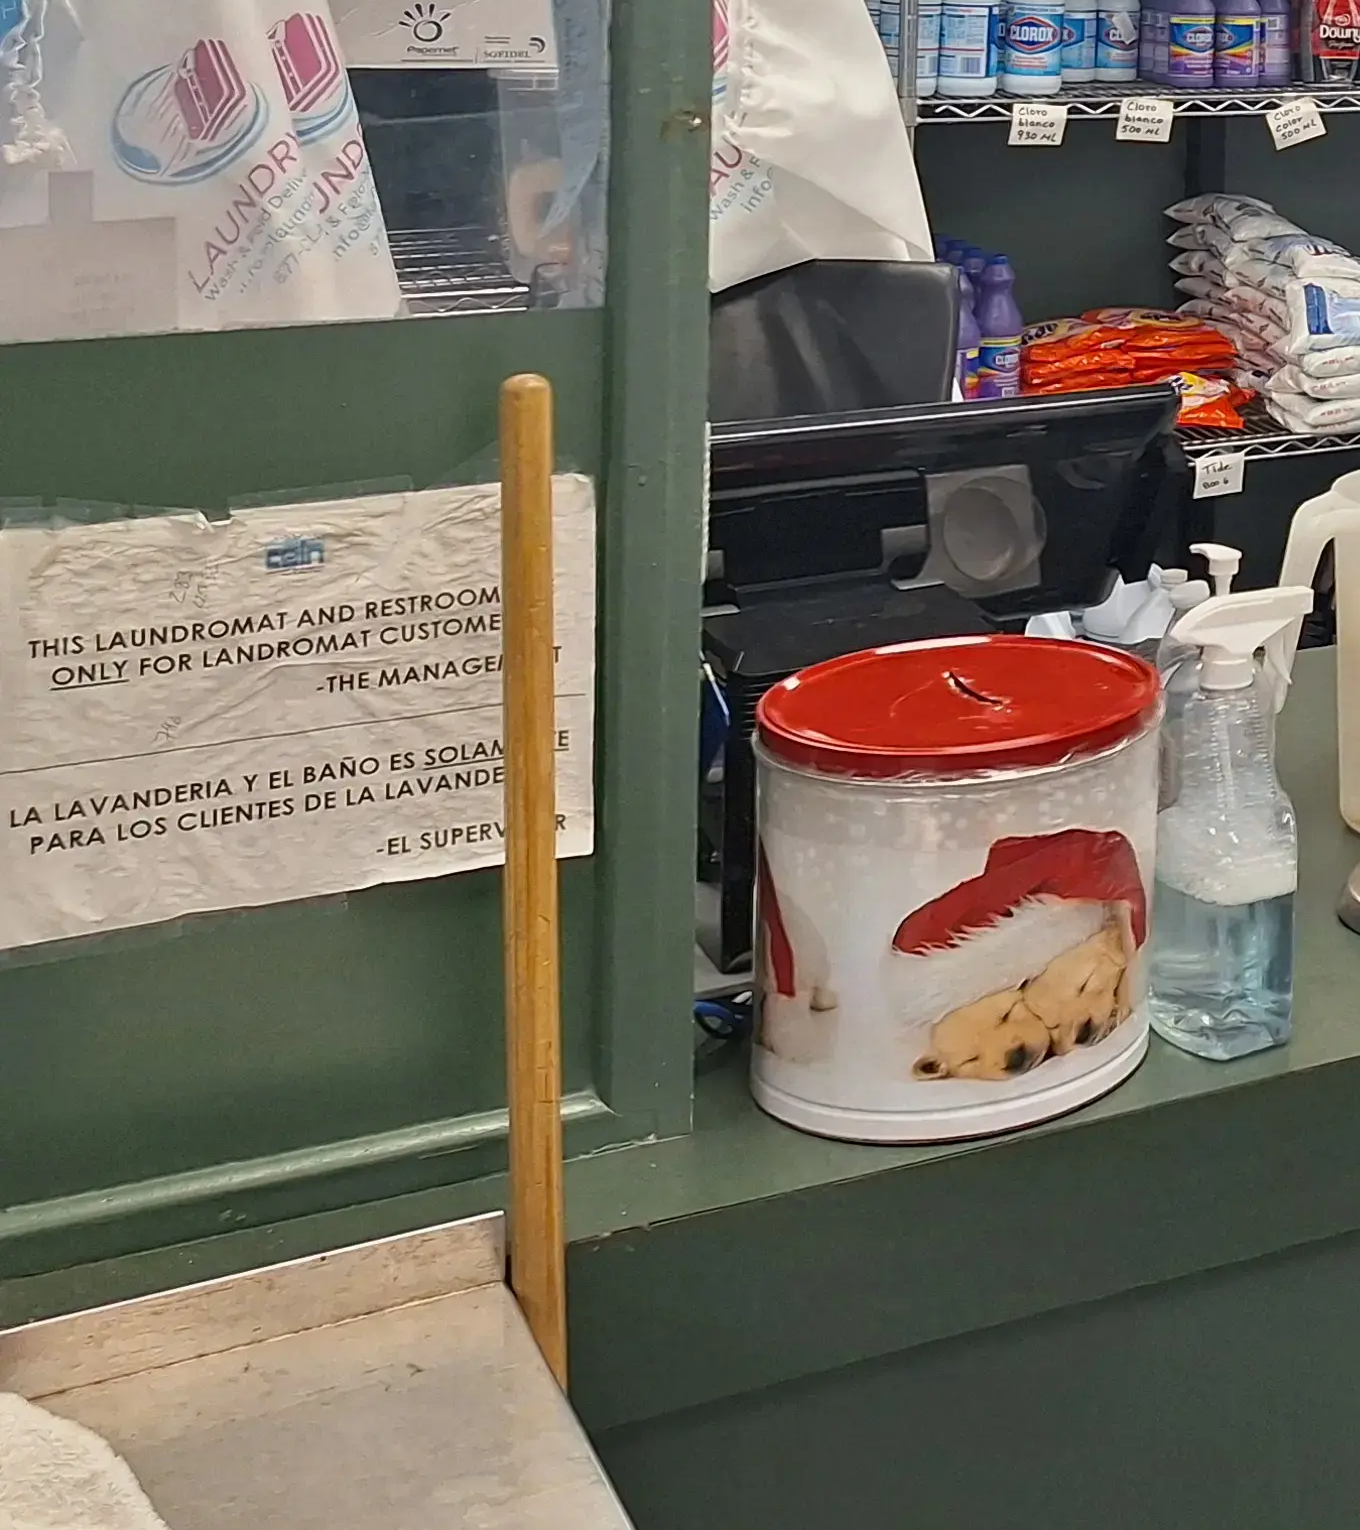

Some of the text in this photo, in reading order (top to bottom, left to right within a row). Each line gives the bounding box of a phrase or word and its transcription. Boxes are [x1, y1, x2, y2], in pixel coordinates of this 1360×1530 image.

[1009, 24, 1054, 42] CLOROX
[1018, 106, 1048, 117] Cloro
[1127, 100, 1157, 112] Cloro
[1017, 130, 1038, 141] 930
[1121, 124, 1142, 134] 500
[1280, 127, 1301, 141] 500
[267, 171, 308, 210] Deliv
[709, 181, 746, 221] Wash
[1202, 462, 1233, 474] Tide
[28, 635, 84, 660] THIS
[95, 612, 289, 652] LAUNDROMAT
[297, 604, 355, 628] AND
[51, 614, 501, 689] ONLY FOR LANDROMAT CUSTOME
[316, 645, 563, 694] -THE MANAGET
[10, 806, 50, 828] LA
[54, 777, 233, 822] LAVANDERIA
[242, 773, 259, 791] Y
[268, 769, 295, 789] EL
[303, 754, 380, 784] BAÑO
[390, 751, 416, 771] ES
[30, 766, 505, 855] PARA LOS CLIENTES DE LA LAVANDE
[376, 813, 567, 856] -EL SUPERVR
